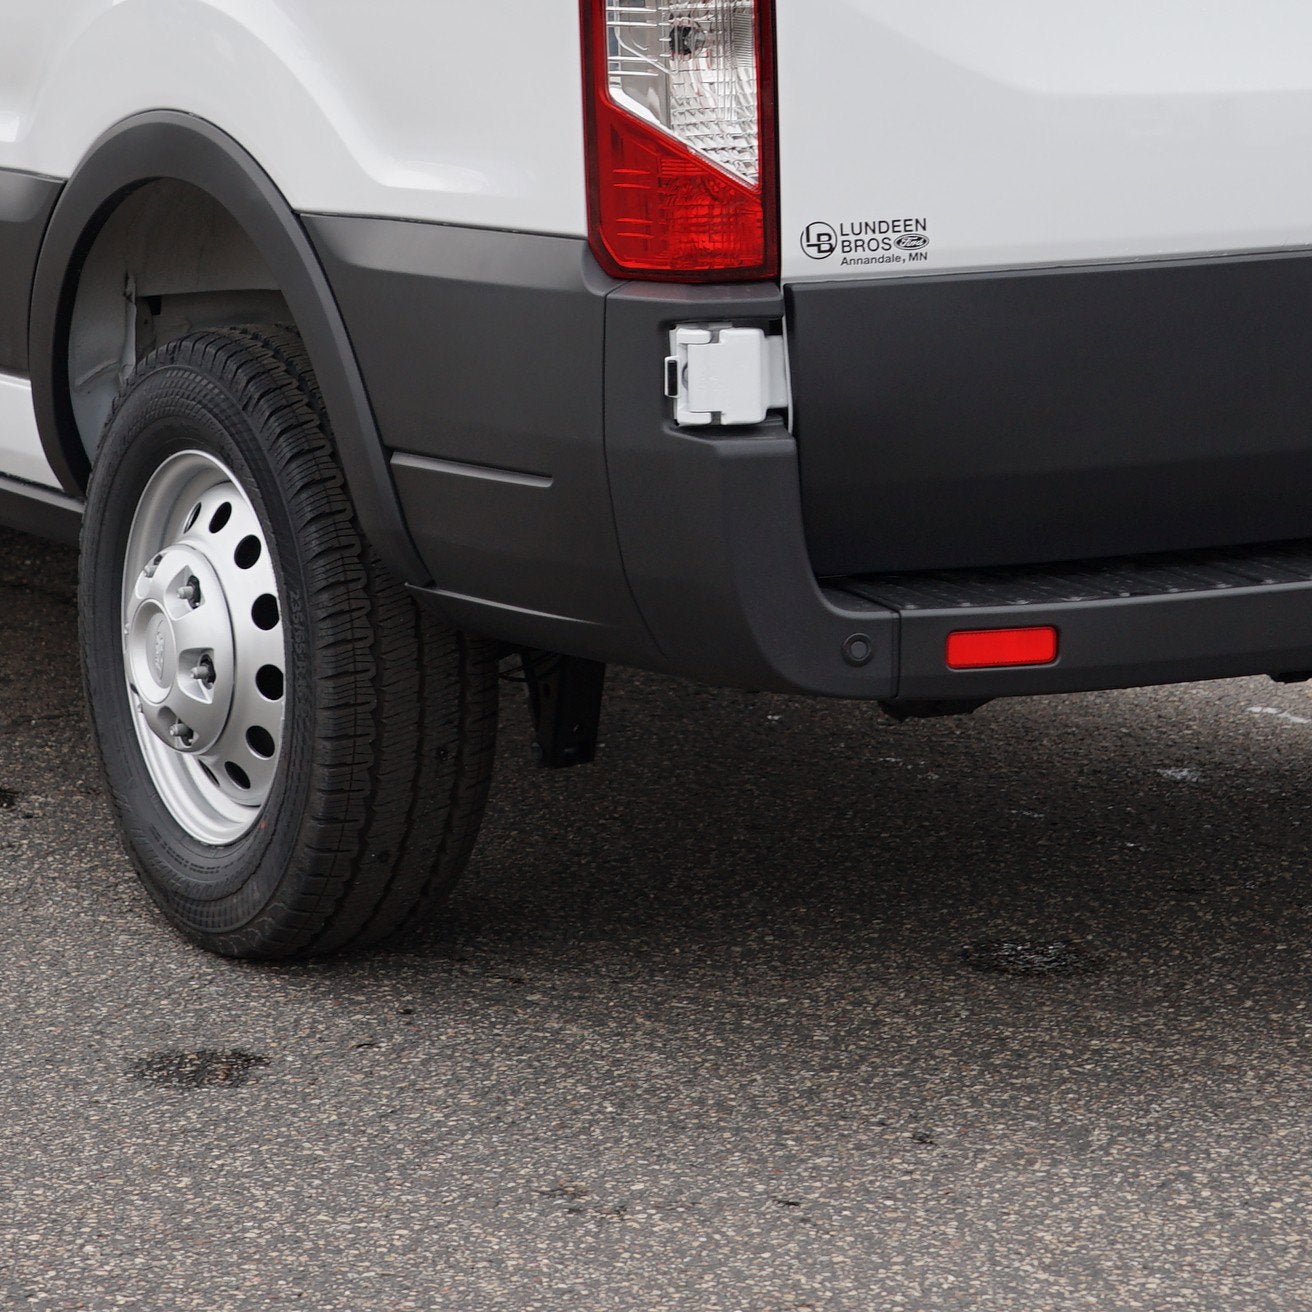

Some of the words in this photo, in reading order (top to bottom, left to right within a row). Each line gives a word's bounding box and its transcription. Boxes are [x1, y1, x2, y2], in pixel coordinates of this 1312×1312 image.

[840, 218, 927, 236] LUNDEEN
[841, 237, 892, 254] BROS
[840, 254, 906, 266] Annandale,
[908, 251, 928, 262] MN
